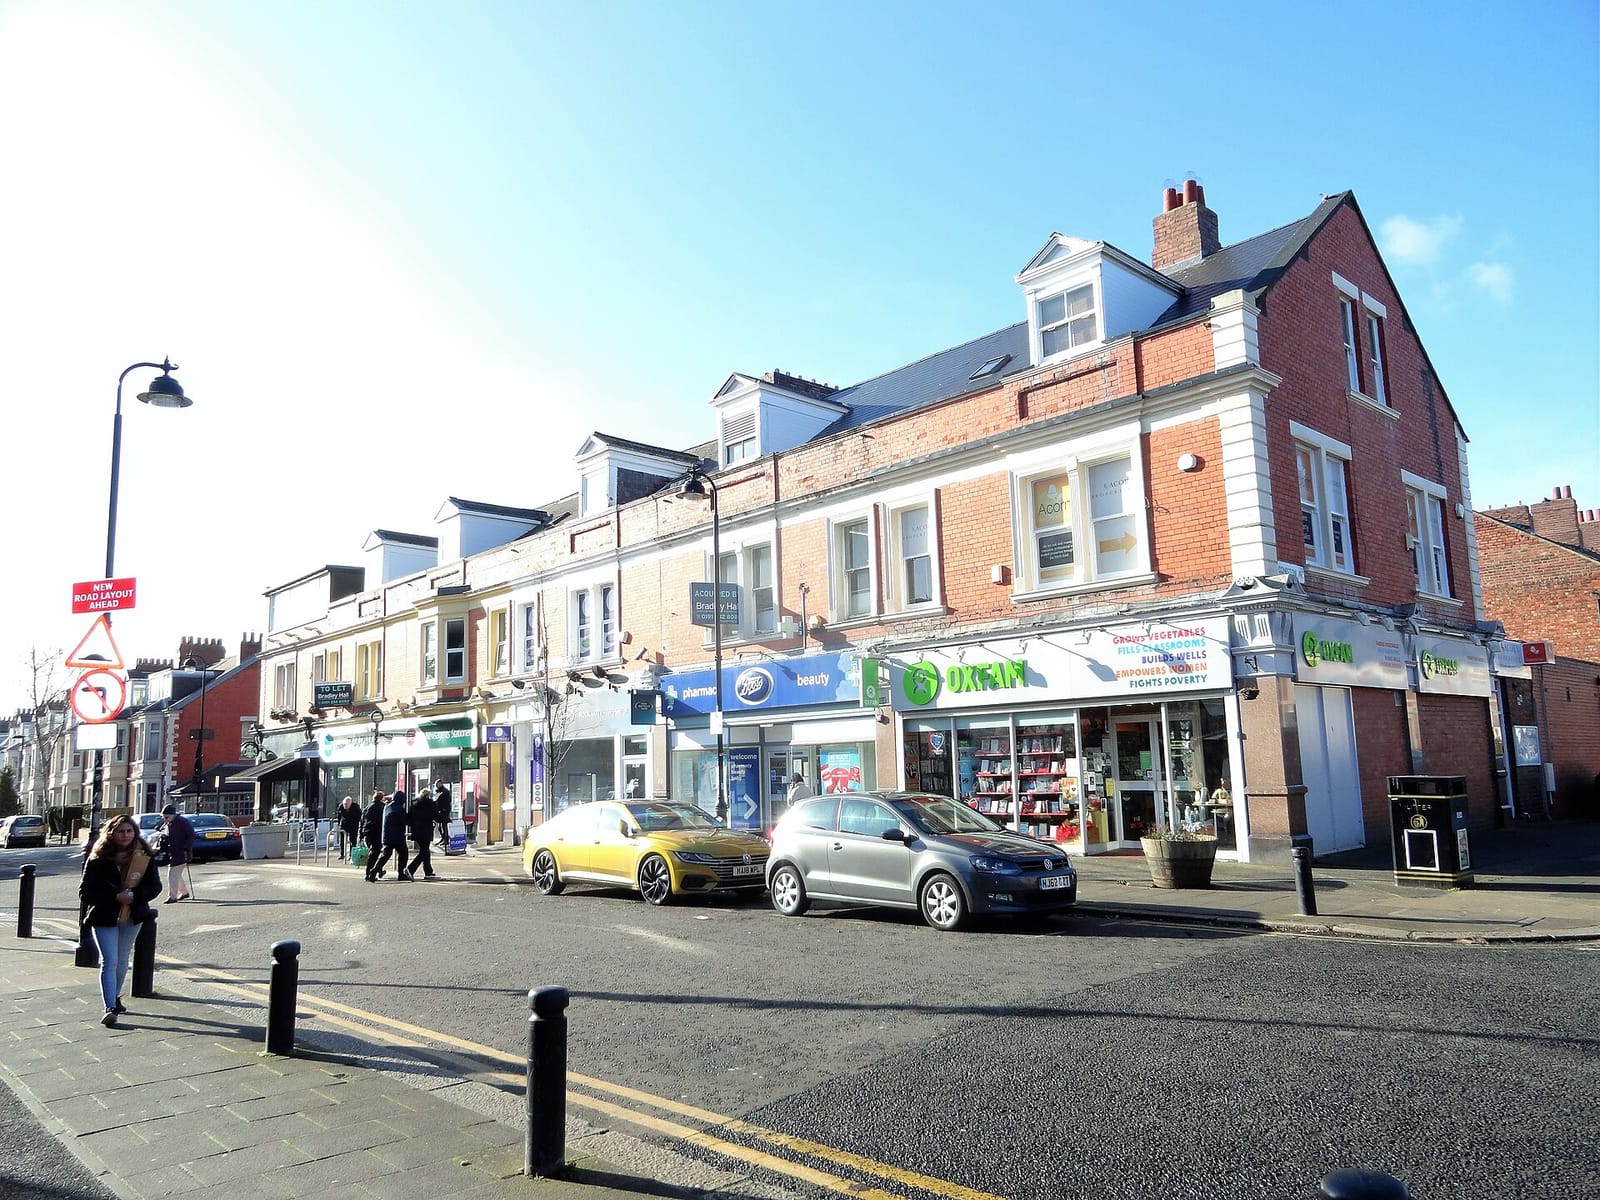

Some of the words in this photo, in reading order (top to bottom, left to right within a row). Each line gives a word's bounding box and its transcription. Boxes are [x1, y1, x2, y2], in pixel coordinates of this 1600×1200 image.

[93, 582, 113, 591] NEW
[695, 590, 731, 598] ACQUED
[74, 592, 99, 602] ROAD
[100, 589, 133, 600] LAYOUT
[89, 600, 119, 609] AHEAD
[696, 602, 725, 612] Brady
[727, 602, 737, 610] Ha
[1113, 635, 1145, 645] GROWS
[1148, 627, 1206, 641] VEGETABLES
[1118, 644, 1141, 655] FILLS
[1142, 639, 1206, 652] CLASSROOMS
[1320, 640, 1353, 663] OXFAM
[1142, 655, 1174, 664] BUILDS
[1177, 650, 1207, 660] WELLS
[946, 659, 1027, 694] OXFAM
[1116, 666, 1167, 679] EMPOWERS
[1169, 662, 1208, 673] WOMEN
[740, 675, 764, 698] Boots
[797, 672, 830, 687] beauty
[1130, 678, 1162, 688] FIGHTS
[1165, 674, 1208, 686] POVERTY
[683, 686, 717, 701] pharmac
